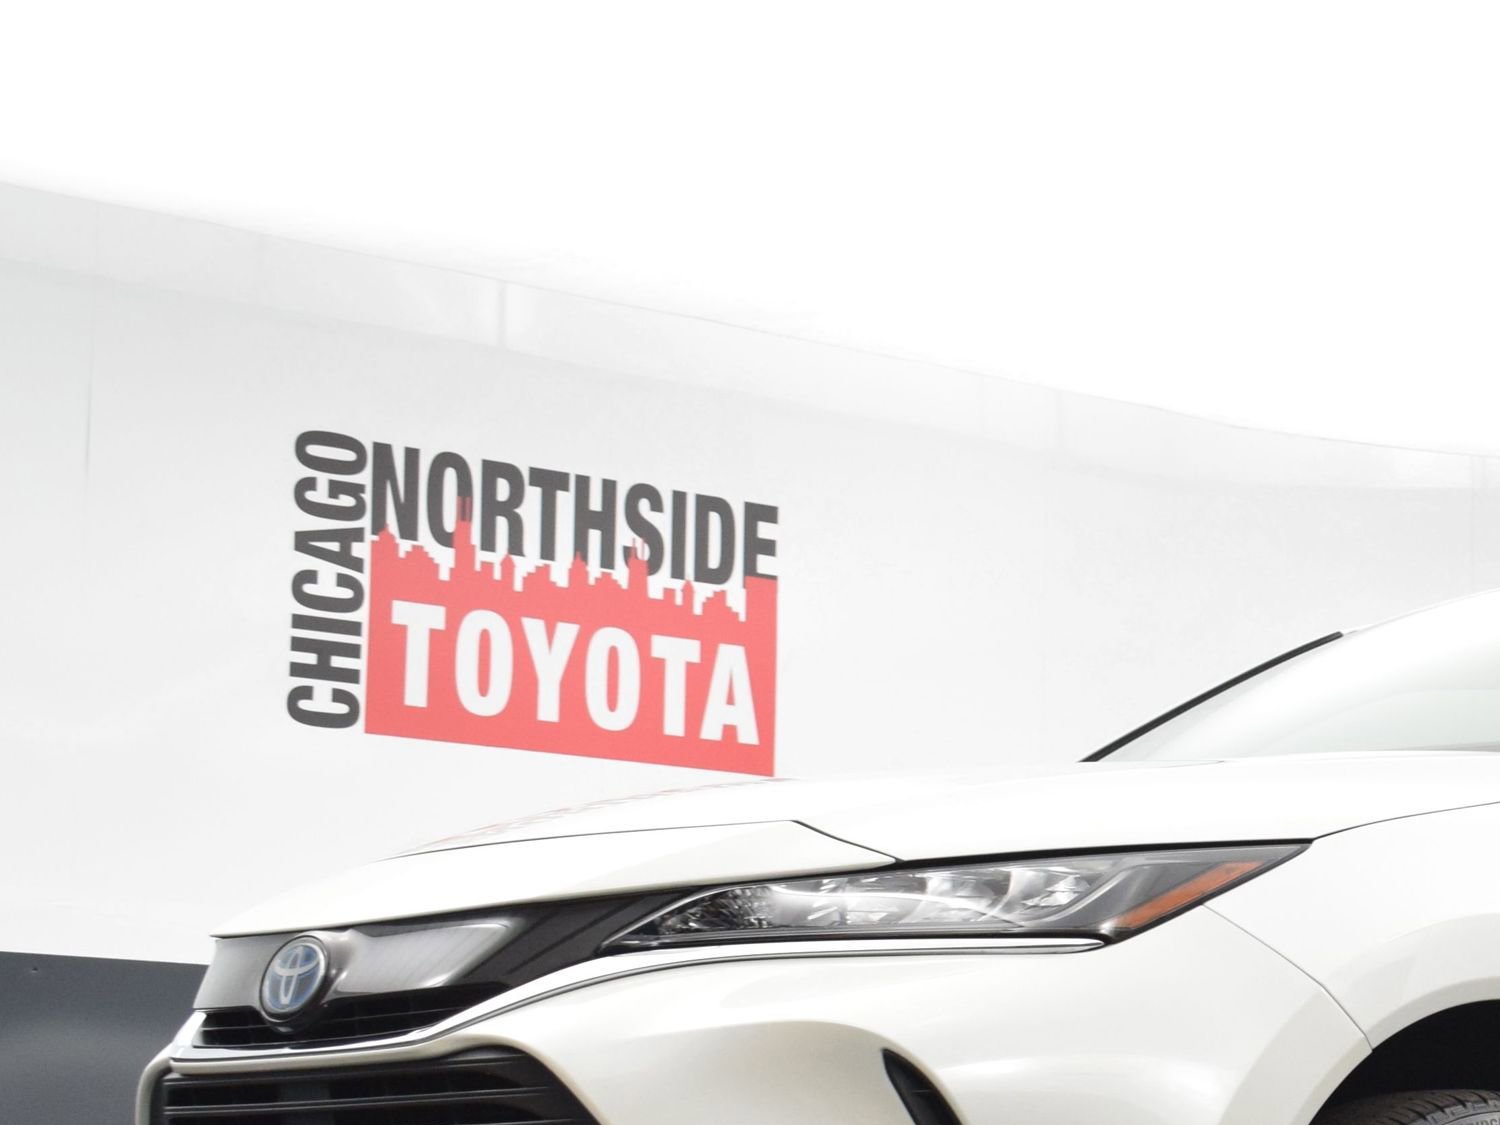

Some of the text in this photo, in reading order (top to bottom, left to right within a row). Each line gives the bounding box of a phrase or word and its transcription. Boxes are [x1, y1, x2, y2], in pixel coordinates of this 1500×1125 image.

[286, 430, 367, 729] CHICAGO
[371, 441, 778, 589] NORTHSIDE
[391, 600, 759, 745] TOYOTA
